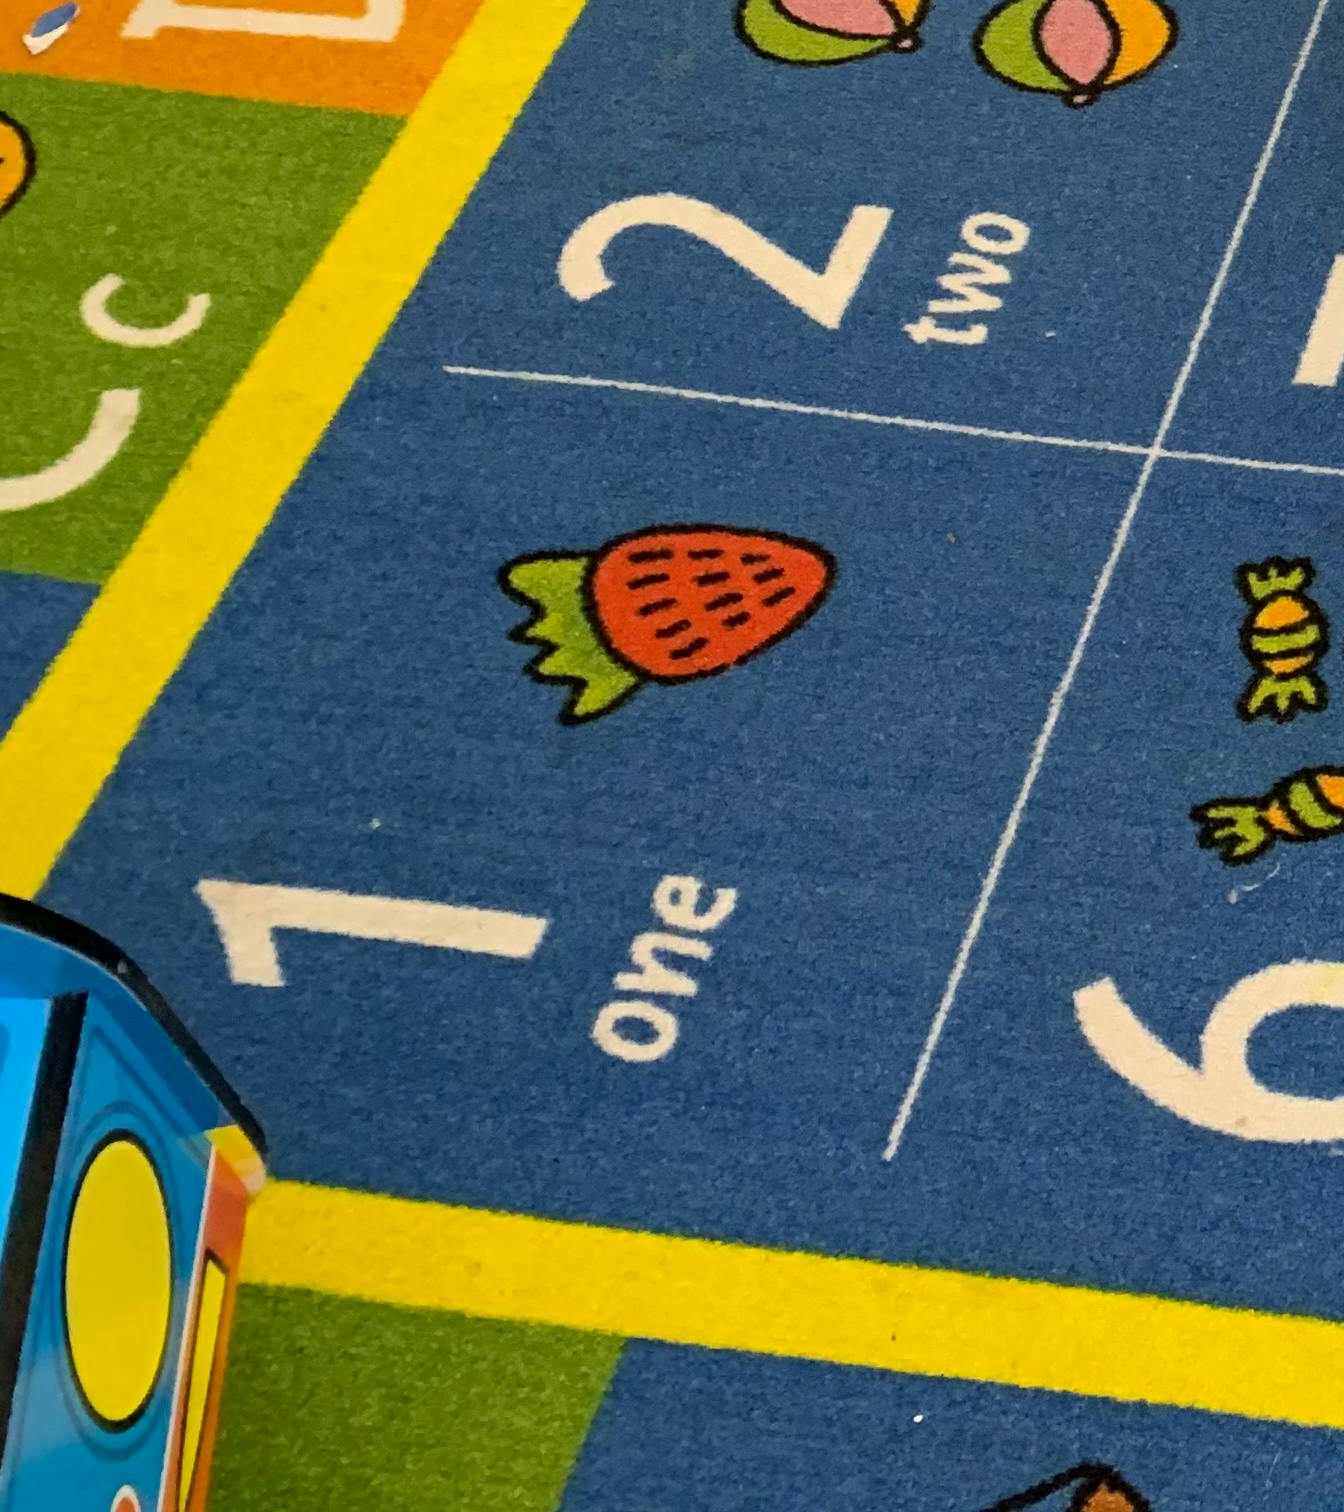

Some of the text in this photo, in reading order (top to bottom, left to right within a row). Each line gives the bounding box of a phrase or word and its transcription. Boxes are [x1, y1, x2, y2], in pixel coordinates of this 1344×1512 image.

[556, 192, 894, 329] 2
[903, 212, 1030, 345] two
[194, 878, 550, 987] 1
[590, 875, 738, 1062] one
